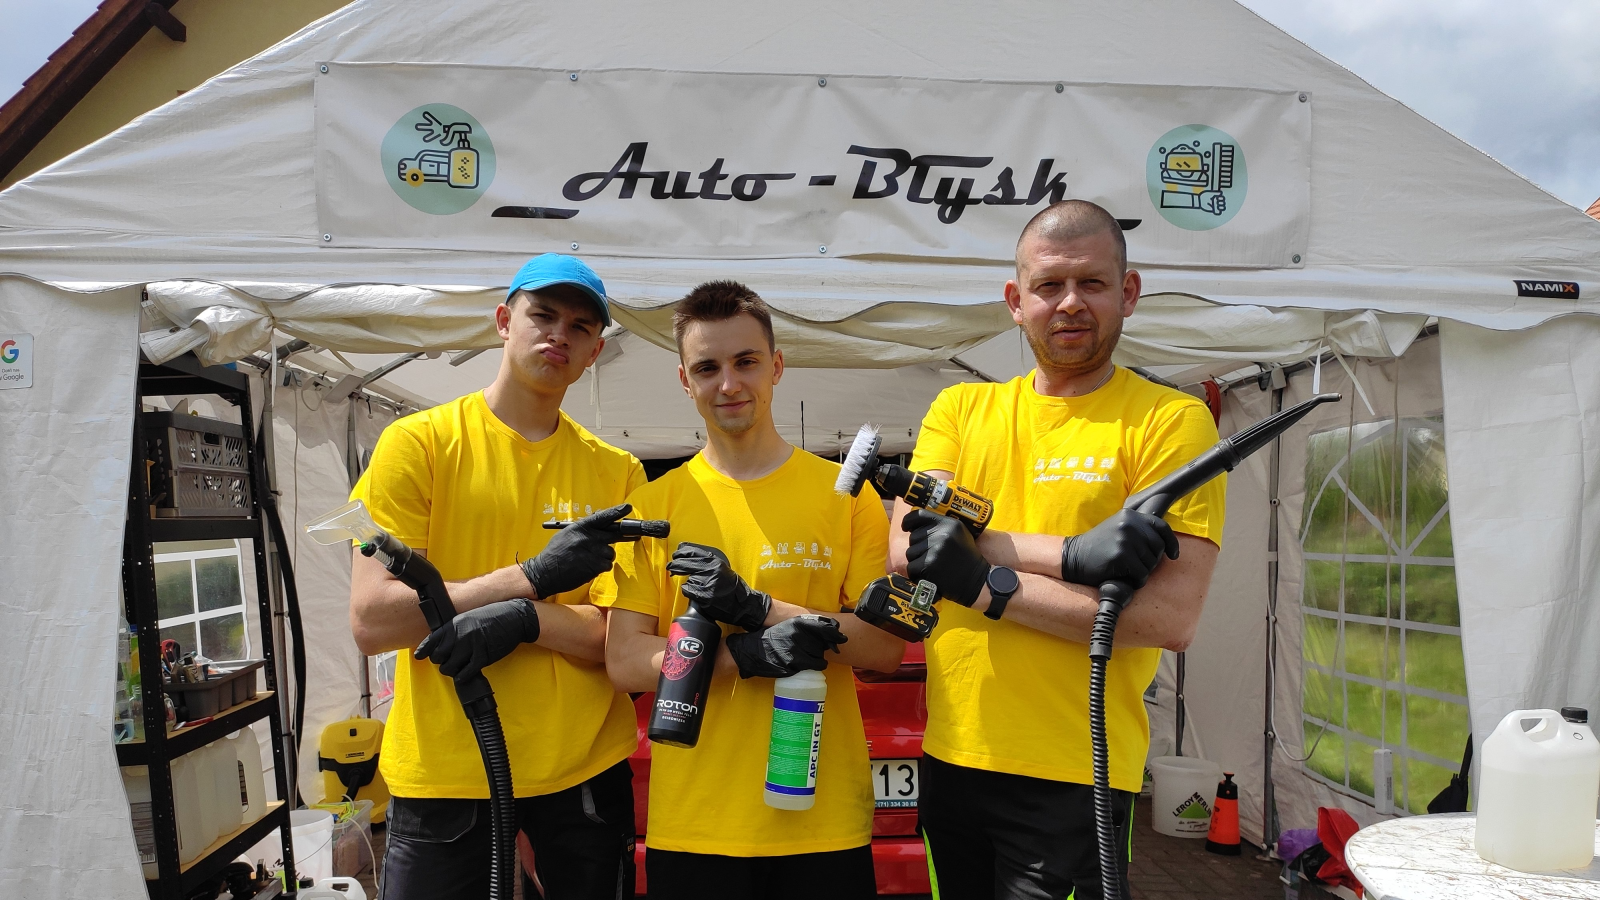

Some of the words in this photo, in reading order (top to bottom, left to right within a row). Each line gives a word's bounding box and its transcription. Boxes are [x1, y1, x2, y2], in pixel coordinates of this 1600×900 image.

[562, 142, 796, 201] Auto
[1521, 282, 1575, 293] NAMIX
[3, 373, 24, 381] Google
[680, 640, 700, 653] K2
[814, 722, 821, 738] GT
[812, 741, 819, 753] IN
[1172, 797, 1194, 817] LEROY
